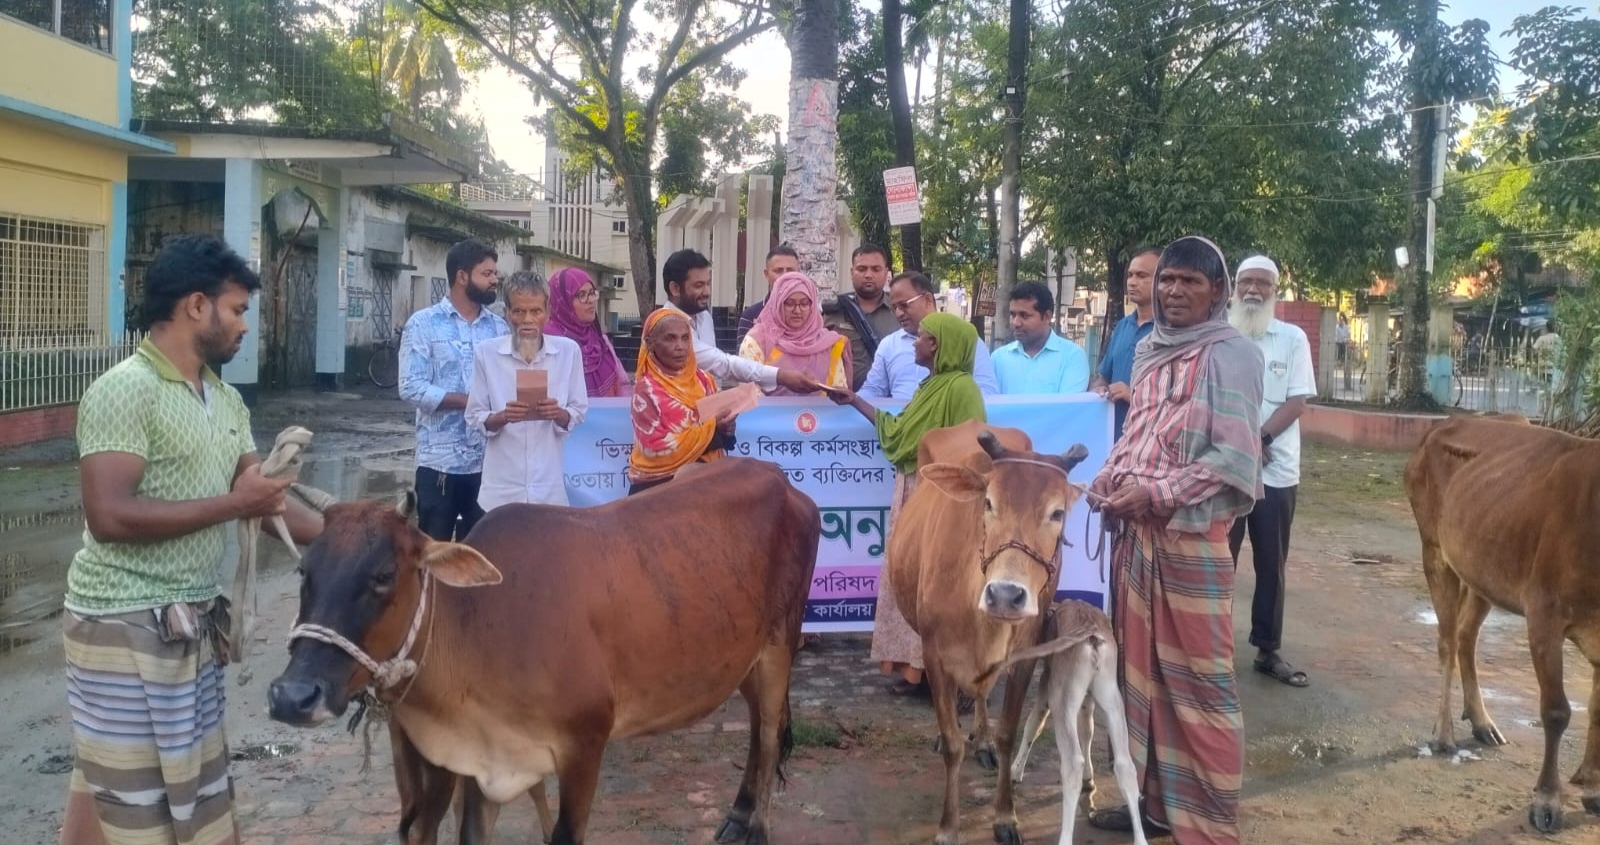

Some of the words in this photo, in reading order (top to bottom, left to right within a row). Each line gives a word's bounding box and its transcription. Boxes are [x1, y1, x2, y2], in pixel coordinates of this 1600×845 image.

[737, 441, 750, 456] ও
[757, 436, 803, 457] বিকল্প
[812, 462, 884, 485] ব্যক্তিদের
[813, 571, 877, 593] পরিষদ
[812, 600, 874, 618] কার্যালয়
